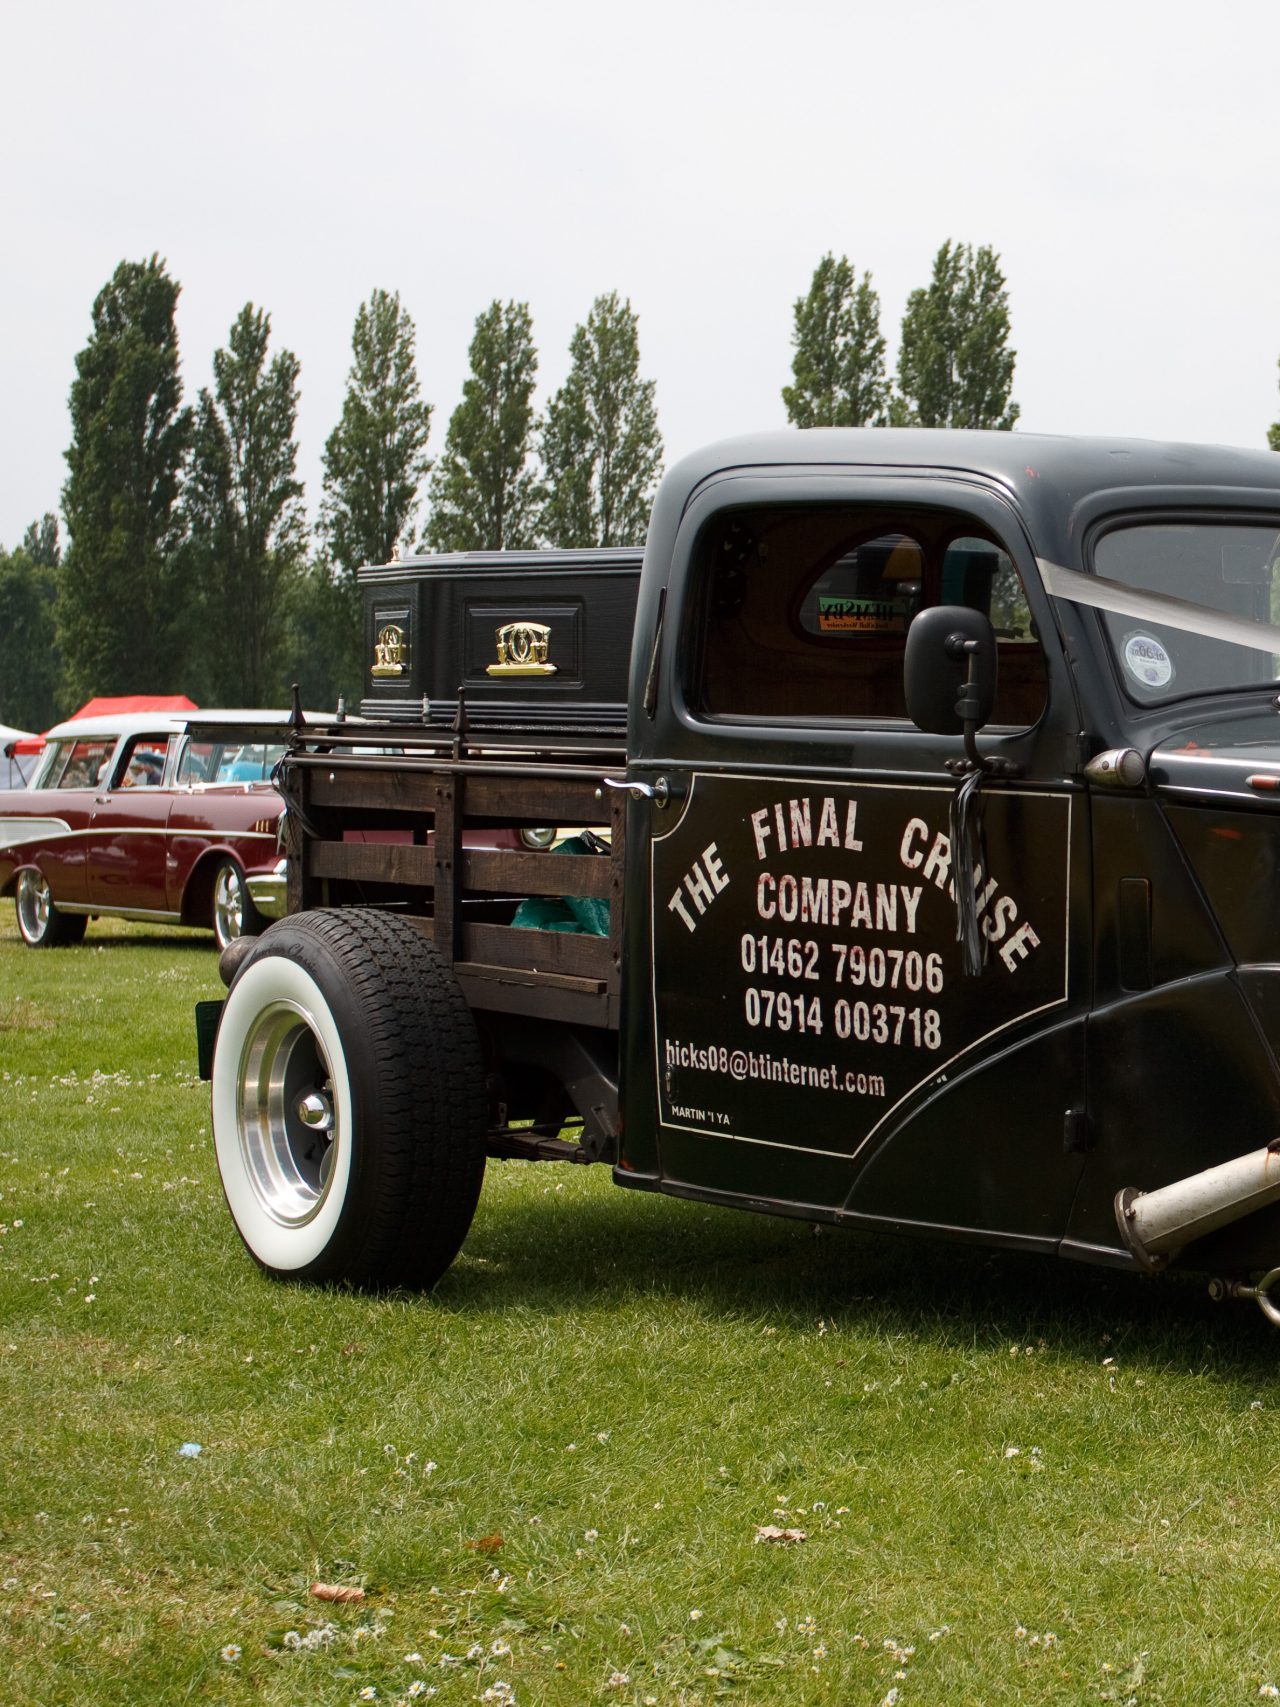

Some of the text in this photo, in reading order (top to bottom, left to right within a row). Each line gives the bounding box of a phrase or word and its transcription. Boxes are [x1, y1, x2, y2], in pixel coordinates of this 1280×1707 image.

[667, 842, 730, 933] THE
[751, 797, 863, 860] FINAL
[757, 872, 923, 934] COMPANY
[741, 934, 944, 993] 01462 790706
[745, 988, 942, 1049] 07914 003718
[665, 1039, 886, 1097] hicks08@btinternet.com
[671, 1105, 706, 1121] MARTIN
